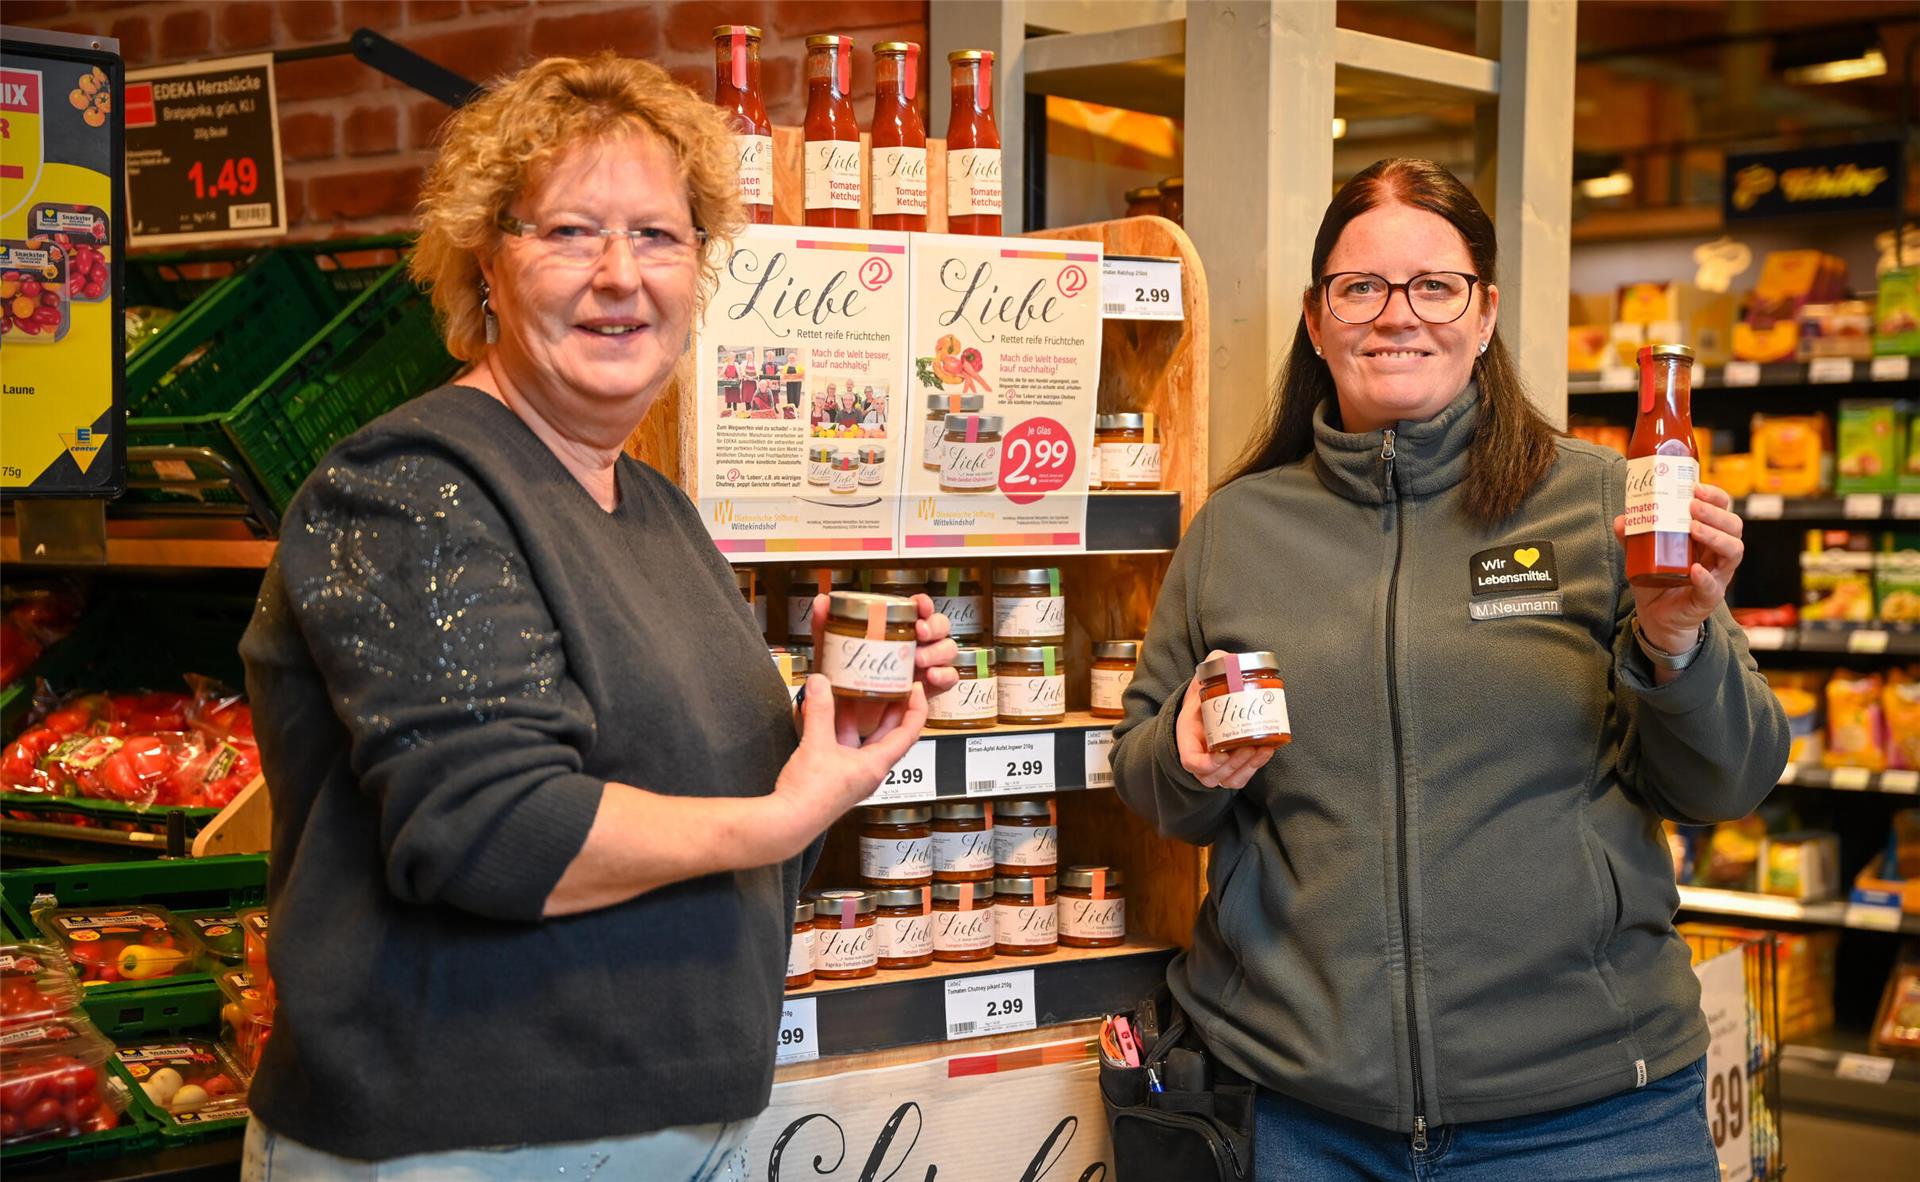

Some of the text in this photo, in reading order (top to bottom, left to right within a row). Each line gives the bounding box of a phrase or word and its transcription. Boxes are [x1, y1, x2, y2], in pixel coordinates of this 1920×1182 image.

[154, 74, 261, 101] EDEKA Herzstücke
[187, 156, 258, 199] 1.49
[728, 249, 867, 338] Liebe
[939, 258, 1064, 343] Liebe
[1135, 287, 1170, 303] 2.99
[797, 329, 891, 342] Rettet reife Früchtchen
[1001, 334, 1085, 346] Rettet reife Früchtchen
[812, 349, 891, 361] Mach die Welt besser,
[1000, 353, 1078, 366] Mach die Welt besser,
[812, 359, 871, 372] kauf nachhaltig!
[1000, 364, 1059, 376] kauf nachhaltig!
[3, 384, 35, 395] Laune
[1624, 502, 1658, 515] omaten
[731, 522, 777, 530] Wittekindshof
[1481, 558, 1506, 571] Wir
[1478, 570, 1552, 586] Lebensmittel.
[1476, 600, 1558, 617] M.Neumann
[842, 640, 899, 674] Liebe
[1006, 760, 1043, 777] 2.99
[885, 768, 923, 785] 2.99
[967, 985, 986, 993] Chutney
[986, 983, 1001, 991] pikant
[986, 998, 1023, 1017] 2.99
